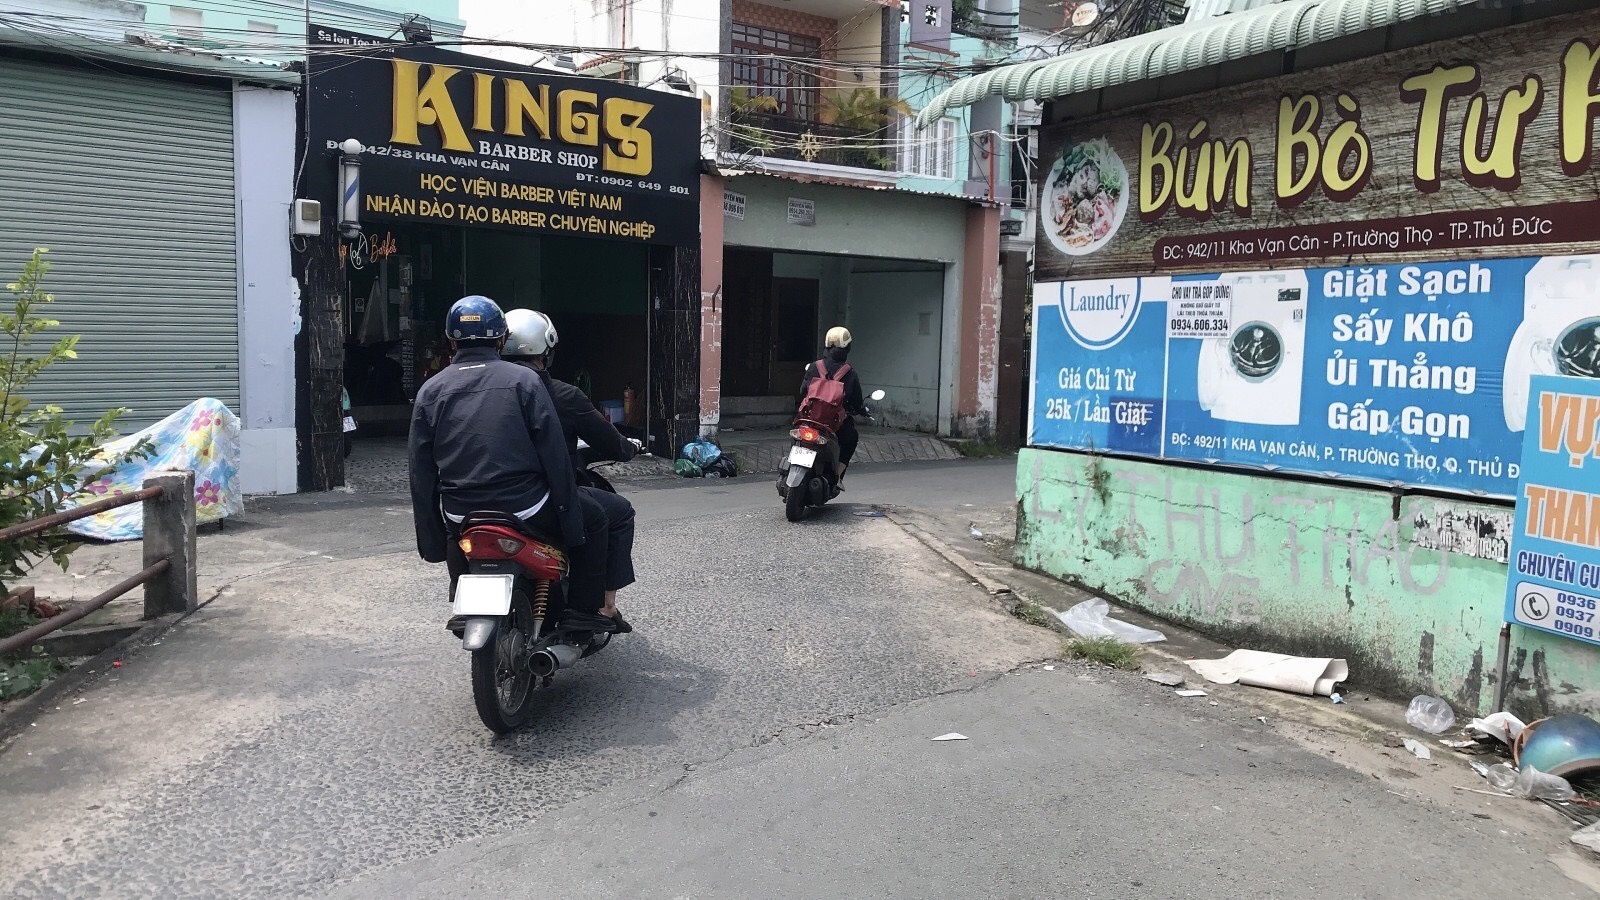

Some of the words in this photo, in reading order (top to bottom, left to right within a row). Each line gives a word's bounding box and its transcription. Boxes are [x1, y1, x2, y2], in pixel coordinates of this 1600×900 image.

[390, 58, 654, 176] KINGS
[479, 140, 552, 165] BARBER
[557, 151, 598, 169] SHOP
[1138, 120, 1252, 215] Bún
[1276, 94, 1369, 200] Bò
[1402, 64, 1540, 183] Tư
[415, 152, 447, 164] KHA
[449, 156, 478, 168] VẠN
[481, 159, 510, 172] CÂN
[420, 173, 457, 195] HỌC
[461, 175, 497, 198] VIỆN
[500, 185, 554, 204] BARBER
[557, 187, 588, 209] VIỆT
[589, 194, 622, 211] NAM
[638, 180, 662, 191] 649
[669, 184, 690, 195] 801
[366, 193, 417, 216] NHẬN
[419, 198, 456, 219] ĐÀO
[458, 203, 489, 224] TẠO
[492, 207, 547, 228] BARBER
[549, 211, 607, 235] CHUYÊN
[608, 218, 656, 240] NGHIỆP
[1163, 245, 1184, 261] ĐC:
[1187, 241, 1226, 260] 942/11
[1229, 238, 1254, 256] Kha
[1257, 237, 1286, 258] Vạn
[1288, 232, 1320, 252] Cân
[1333, 228, 1399, 255] P.Trường
[1405, 225, 1434, 248] Thọ
[1449, 214, 1506, 243] TP.Thủ
[1511, 215, 1554, 237] Đức
[1069, 285, 1130, 318] Laundry
[1171, 286, 1182, 299] CHO
[1183, 286, 1191, 299] VAY
[1323, 267, 1388, 303] Giặt
[1399, 263, 1492, 302] Sạch
[1171, 318, 1228, 330] 0934.606.334
[1333, 308, 1394, 346] Sấy
[1403, 311, 1474, 342] Khô
[1058, 368, 1081, 390] Giá
[1085, 366, 1110, 391] Chỉ
[1114, 369, 1136, 392] Từ
[1326, 349, 1358, 386] Ủi
[1369, 352, 1476, 395] Thẳng
[1046, 398, 1071, 420] 25k
[1084, 394, 1110, 423] Lần
[1115, 401, 1148, 433] Giặt
[1328, 398, 1389, 436] Gấp
[1401, 405, 1470, 444] Gọn
[1540, 392, 1600, 467] VỰ
[1172, 433, 1191, 446] ĐC:
[1194, 434, 1227, 449] 492/11
[1232, 437, 1255, 451] KHA
[1261, 441, 1285, 456] VẠN
[1289, 440, 1320, 461] CÂN,
[1324, 448, 1335, 461] P.
[1339, 446, 1399, 467] TRƯỜNG
[1404, 453, 1440, 474] THỌ,
[1444, 458, 1462, 473] Q.
[1468, 455, 1502, 478] THỦ
[1518, 551, 1576, 583] CHUYÊN
[1556, 606, 1595, 623] 0937
[1557, 592, 1596, 610] 0936
[1554, 620, 1593, 637] 0909
